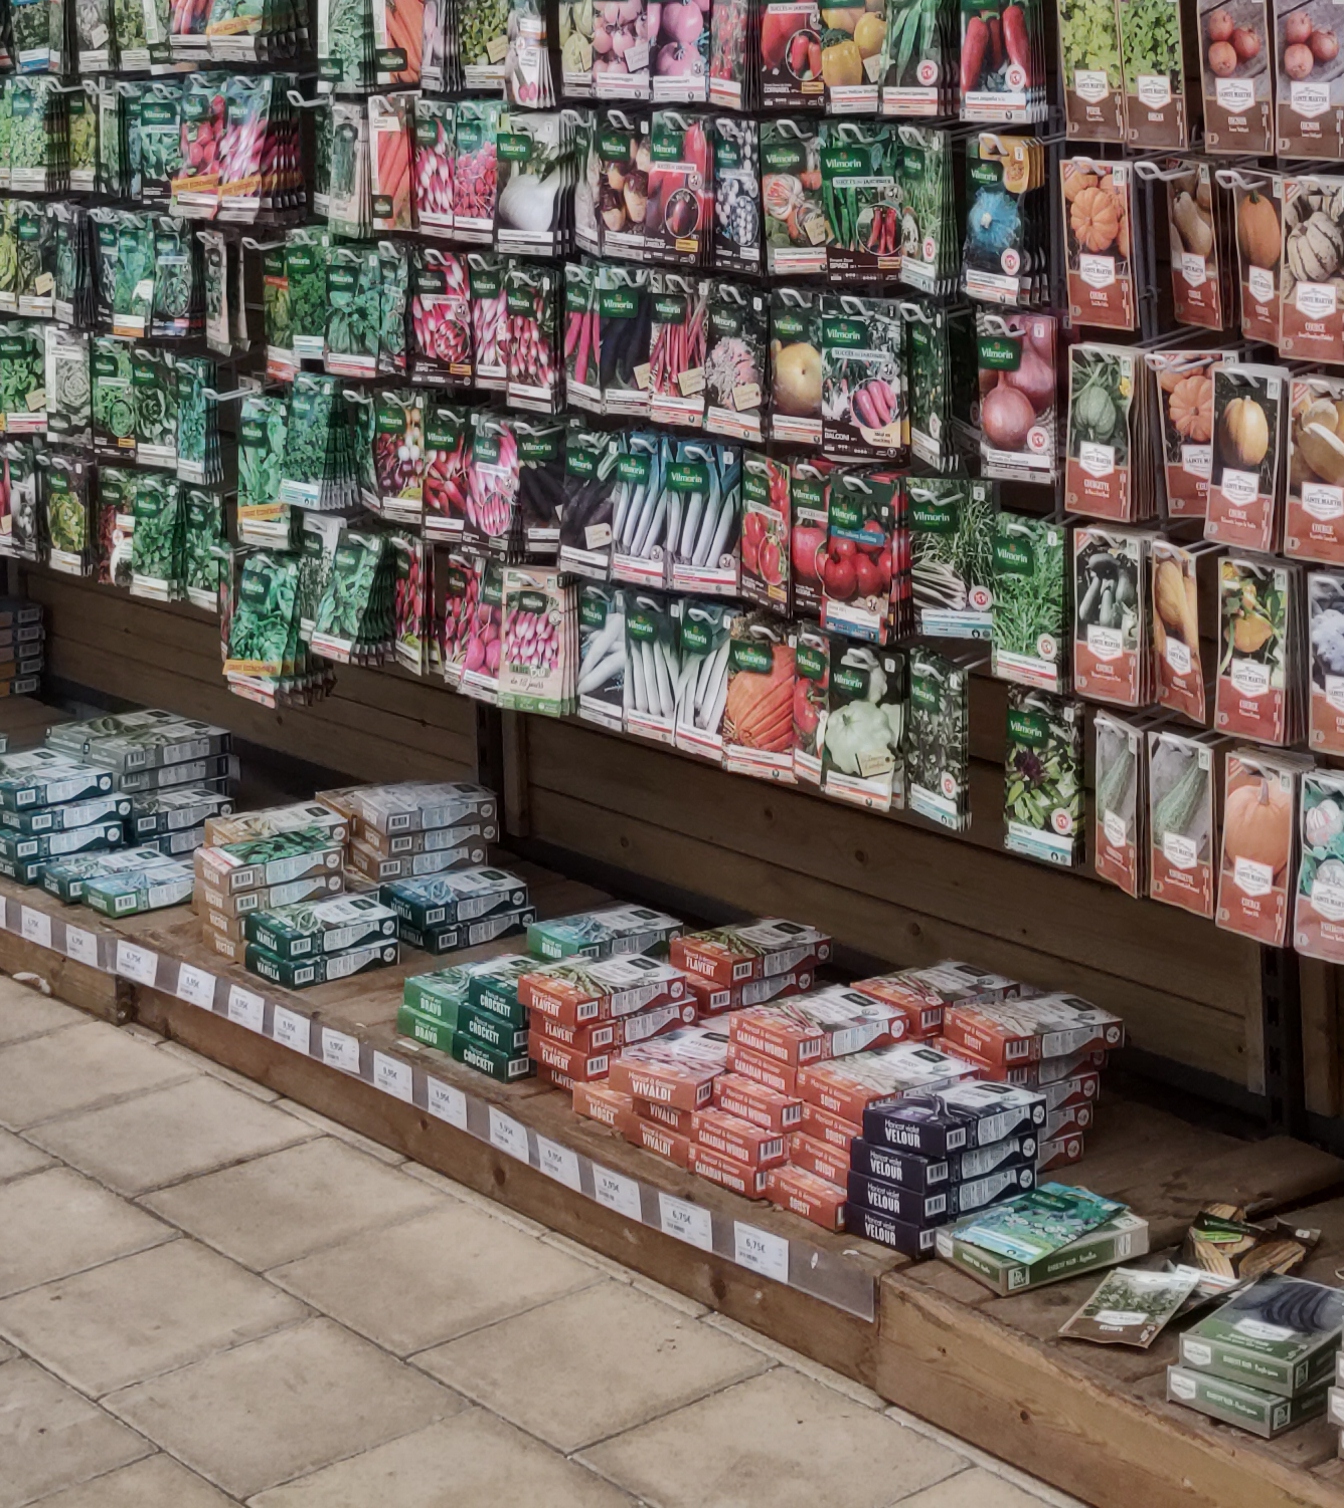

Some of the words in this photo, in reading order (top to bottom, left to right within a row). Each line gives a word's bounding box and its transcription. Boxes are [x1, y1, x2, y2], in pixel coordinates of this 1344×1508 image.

[826, 157, 862, 170] Vilmorin
[981, 347, 1013, 361] Vilmorin
[913, 511, 950, 523] Vilmorin
[1011, 721, 1043, 738] Vilmorin
[480, 995, 511, 1018] CROCKETT
[532, 995, 560, 1018] FLAVERT
[469, 1022, 500, 1045] CROCKETT
[545, 1022, 573, 1044] FLAVERT
[736, 1030, 763, 1053] CANADIAN
[764, 1043, 789, 1062] WONDER
[463, 1049, 495, 1074] CROCKETT
[632, 1081, 672, 1102] VIVALDI
[649, 1104, 679, 1127] VIVALDI
[721, 1094, 747, 1114] CANADIAN
[748, 1106, 772, 1126] WONDER
[885, 1119, 903, 1131] Haricot
[642, 1132, 671, 1157] VIVALDI
[885, 1127, 921, 1148] VELOUR
[870, 1159, 903, 1181] VELOUR
[867, 1191, 900, 1214] VELOUR
[864, 1222, 896, 1247] VELOUR
